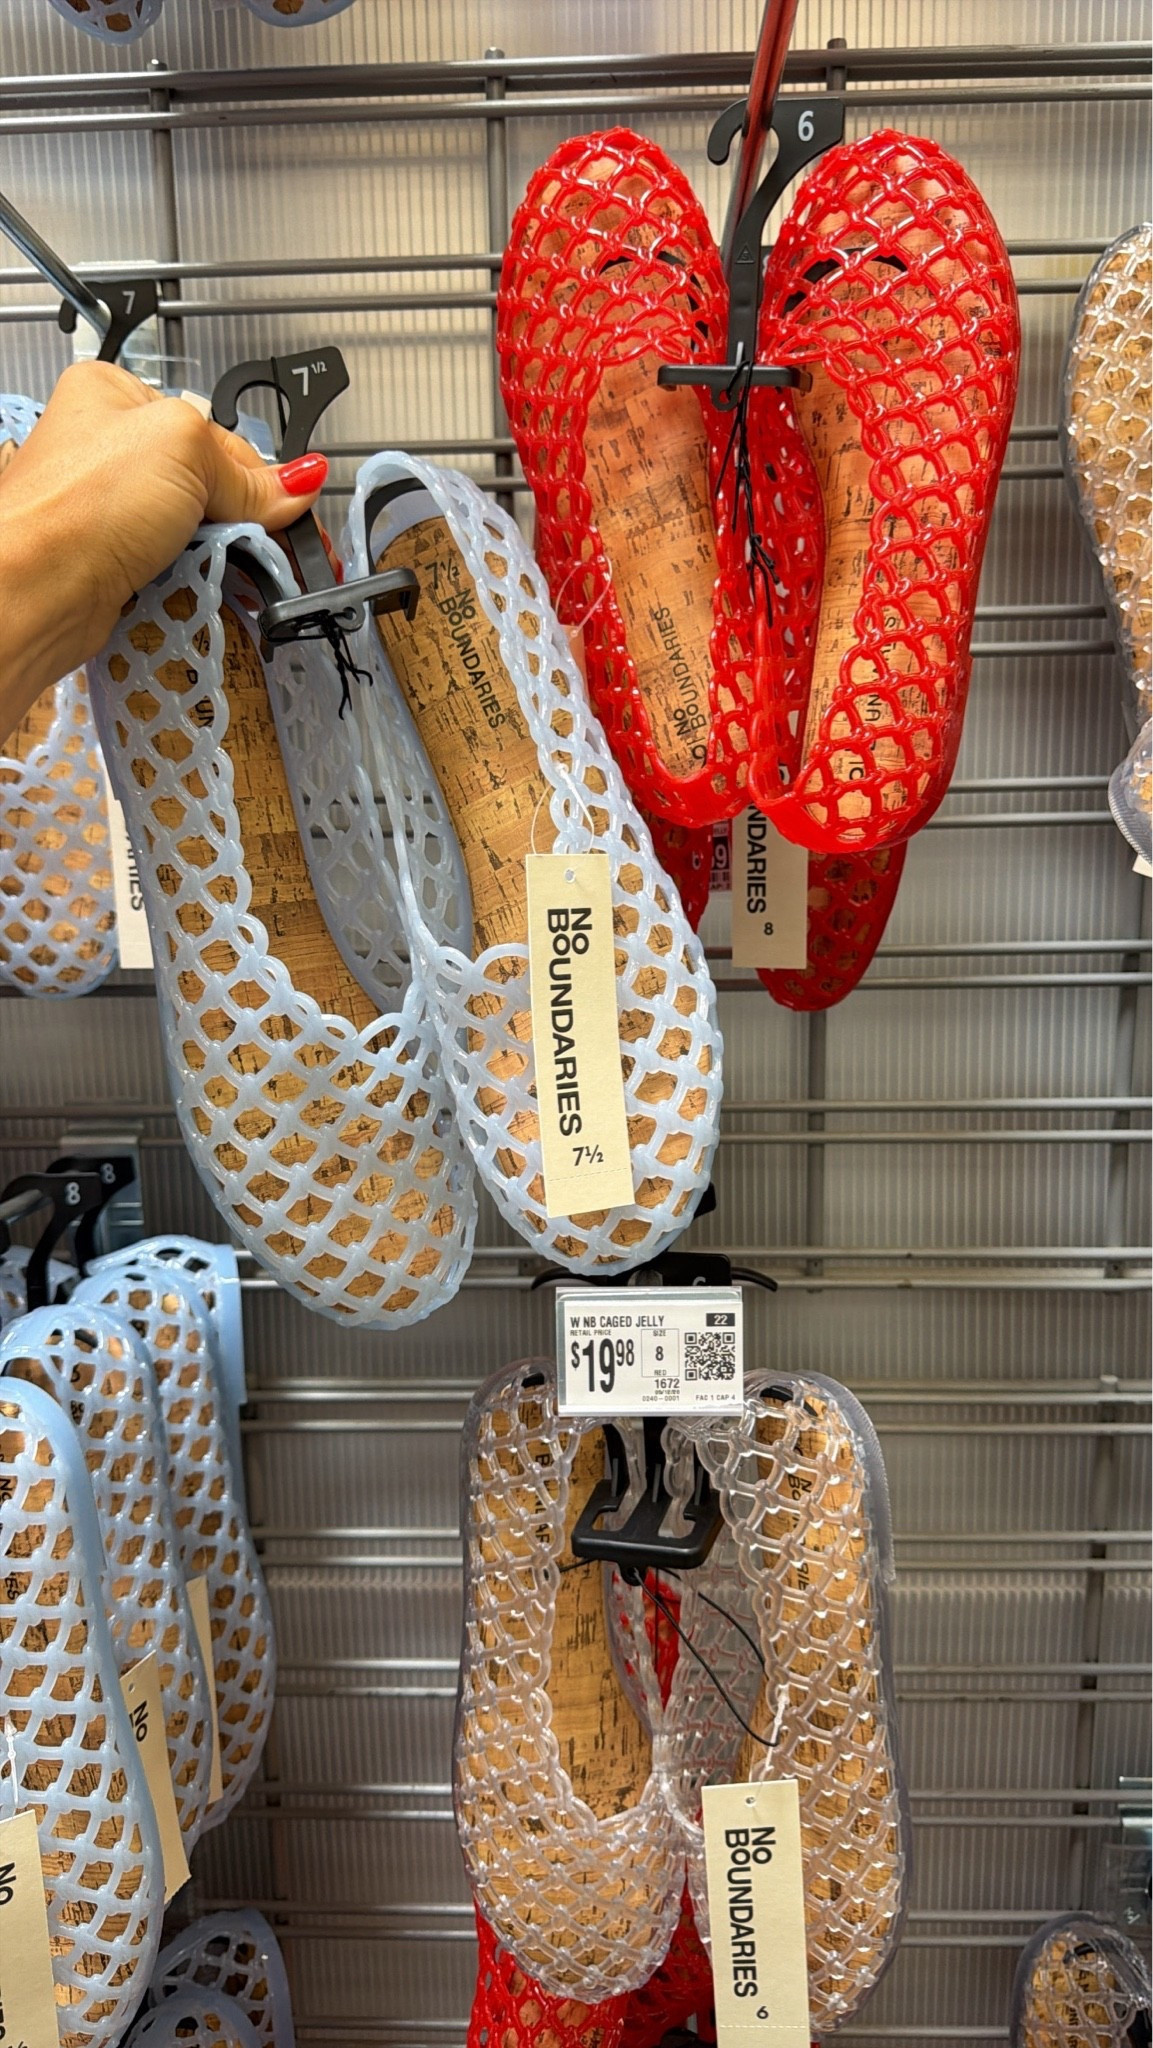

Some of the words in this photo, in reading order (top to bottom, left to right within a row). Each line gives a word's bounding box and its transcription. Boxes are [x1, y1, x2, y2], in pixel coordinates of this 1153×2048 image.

[797, 110, 815, 142] 6
[122, 290, 136, 315] 7
[455, 588, 477, 620] NO
[438, 596, 506, 730] BOUNDARIES
[653, 606, 707, 731] BOUNDARIES
[673, 708, 691, 737] NO
[570, 907, 593, 954] NO
[763, 921, 774, 936] 8
[547, 908, 583, 1137] BOUNDARIES
[101, 1162, 116, 1184] 8
[65, 1181, 81, 1206] 8
[570, 1316, 580, 1329] W
[583, 1316, 597, 1328] NB
[600, 1315, 632, 1328] CAGED
[636, 1315, 665, 1328] JELLY
[713, 1314, 728, 1325] 22
[655, 1345, 664, 1362] 8
[654, 1379, 680, 1389] 1672
[134, 1700, 149, 1742] NO
[751, 1826, 776, 1865] NO
[725, 1828, 758, 1998] BOUNDARIES
[756, 2005, 769, 2020] 6
